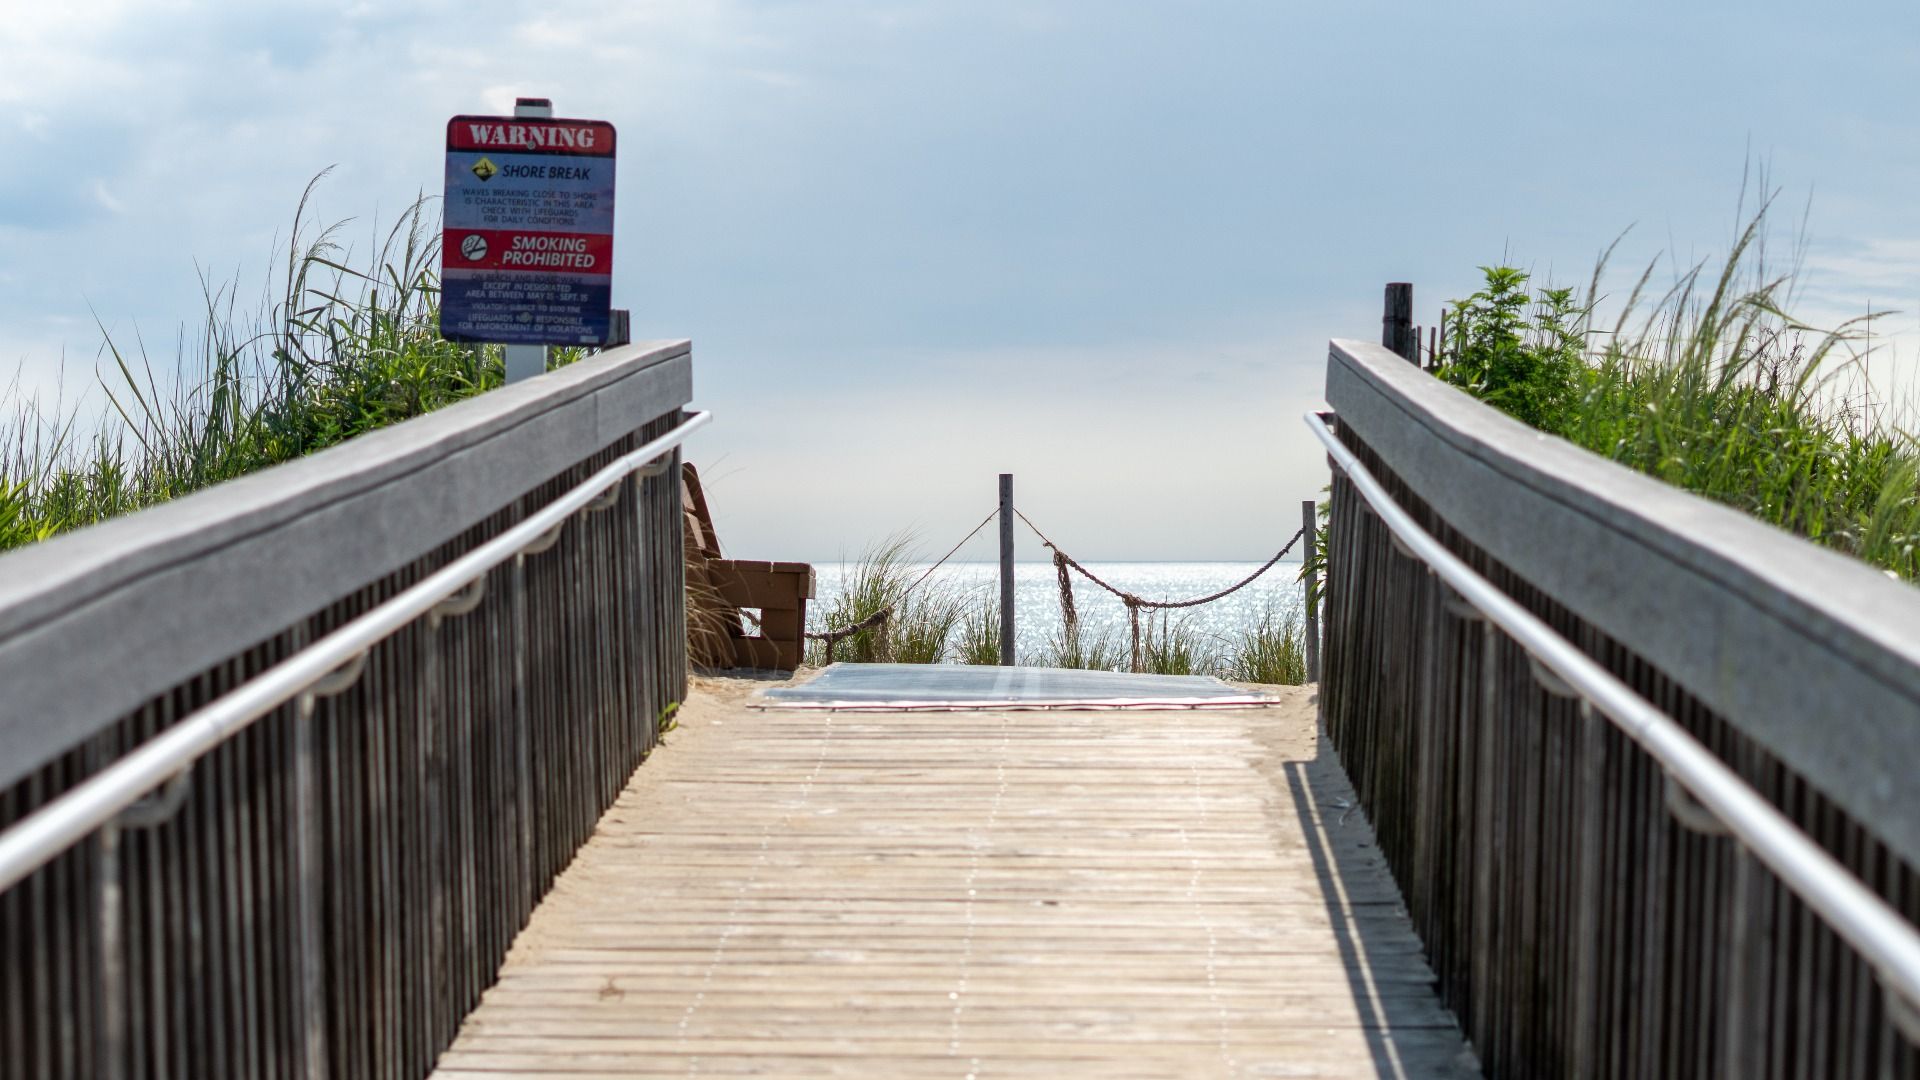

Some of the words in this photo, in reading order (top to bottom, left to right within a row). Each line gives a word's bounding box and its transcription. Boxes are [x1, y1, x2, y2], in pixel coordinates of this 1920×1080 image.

[469, 124, 594, 148] WARNING
[502, 165, 546, 178] SHORE
[548, 167, 591, 180] BREAK
[475, 198, 540, 206] CHARACTERISTIC
[534, 208, 578, 217] LIFEGUARDS
[512, 236, 586, 252] SMOKING
[502, 251, 595, 268] PROHIBITED
[524, 283, 572, 292] DESIGNATED
[489, 291, 524, 299] BETWEEN
[468, 313, 513, 322] LIFEGUARDS
[536, 316, 583, 325] RESPONSIBLE
[476, 323, 531, 331] ENFORCEMENT
[547, 325, 593, 334] VIOLATIONS
